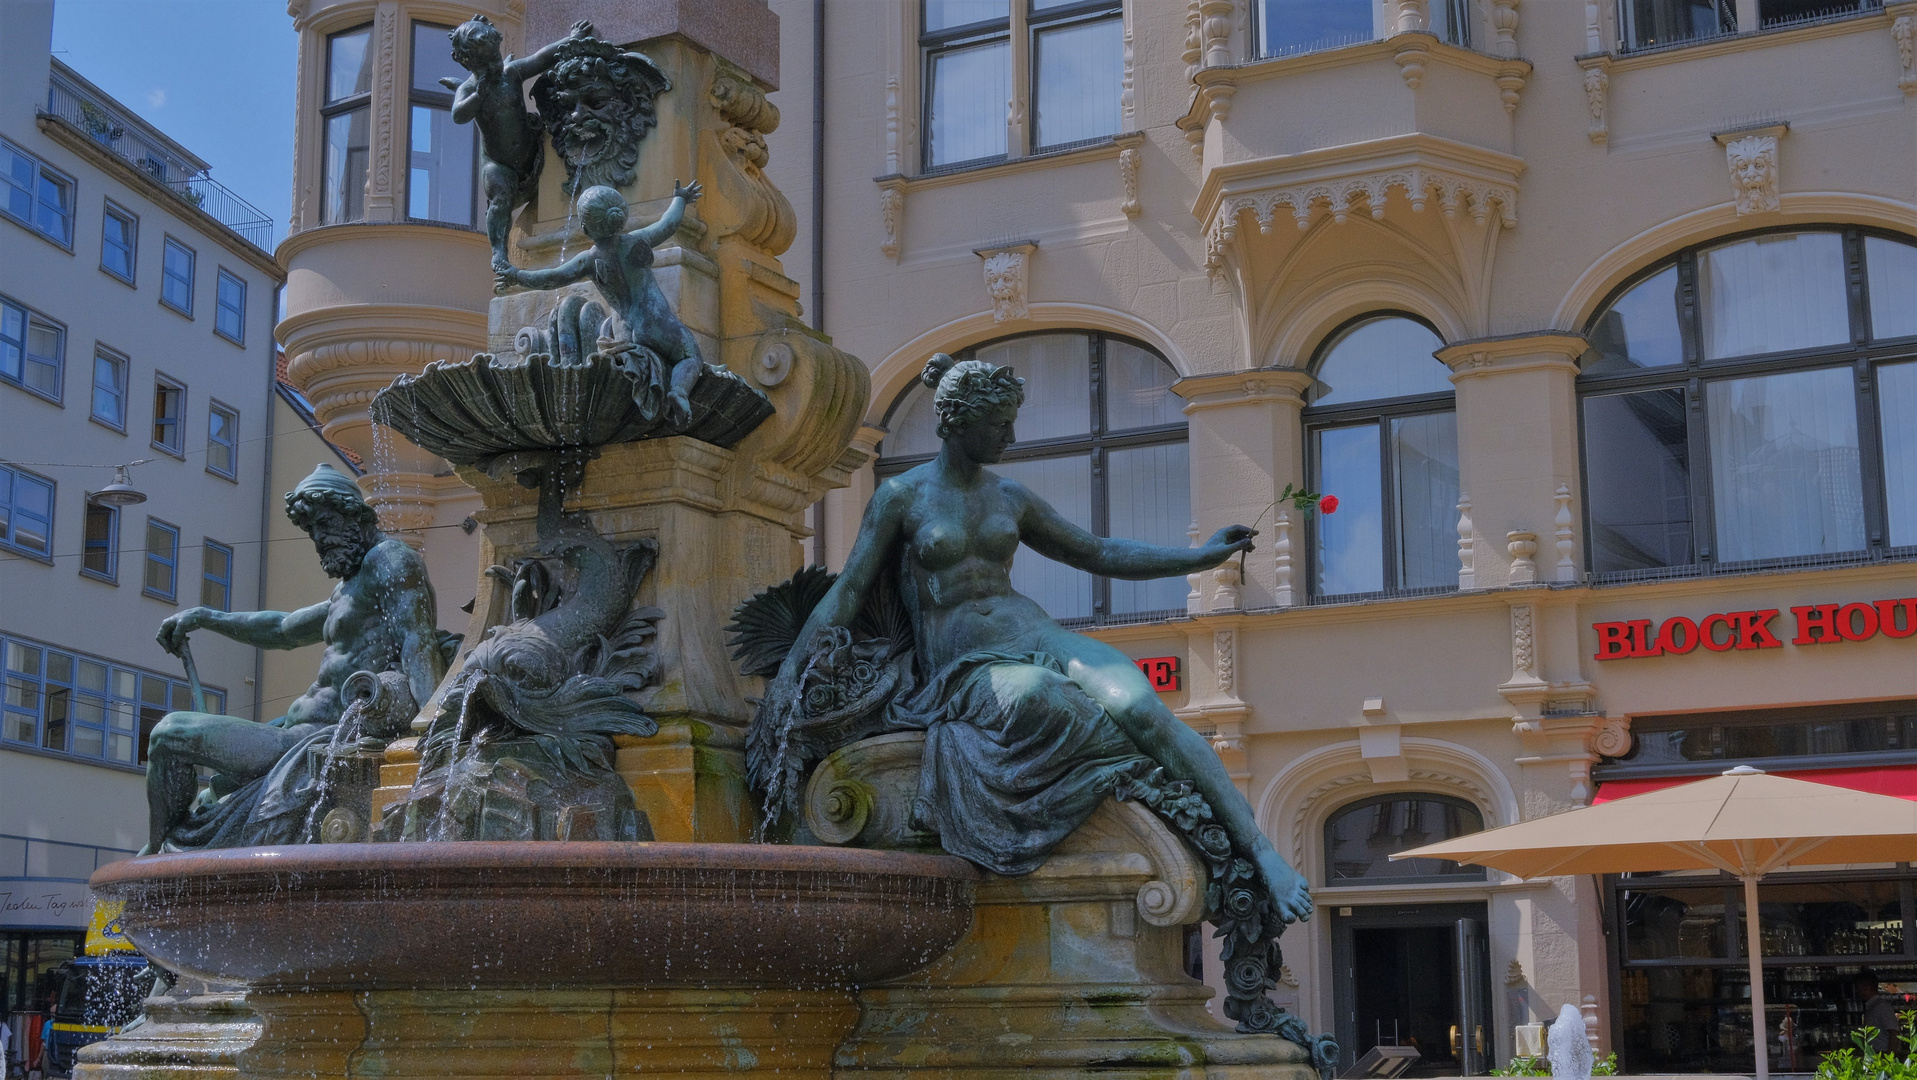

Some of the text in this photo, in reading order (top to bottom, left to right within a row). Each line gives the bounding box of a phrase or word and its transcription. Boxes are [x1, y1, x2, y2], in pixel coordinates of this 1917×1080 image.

[1592, 608, 1782, 660] BLOCK
[1132, 656, 1181, 692] E
[42, 893, 67, 917] Tag
